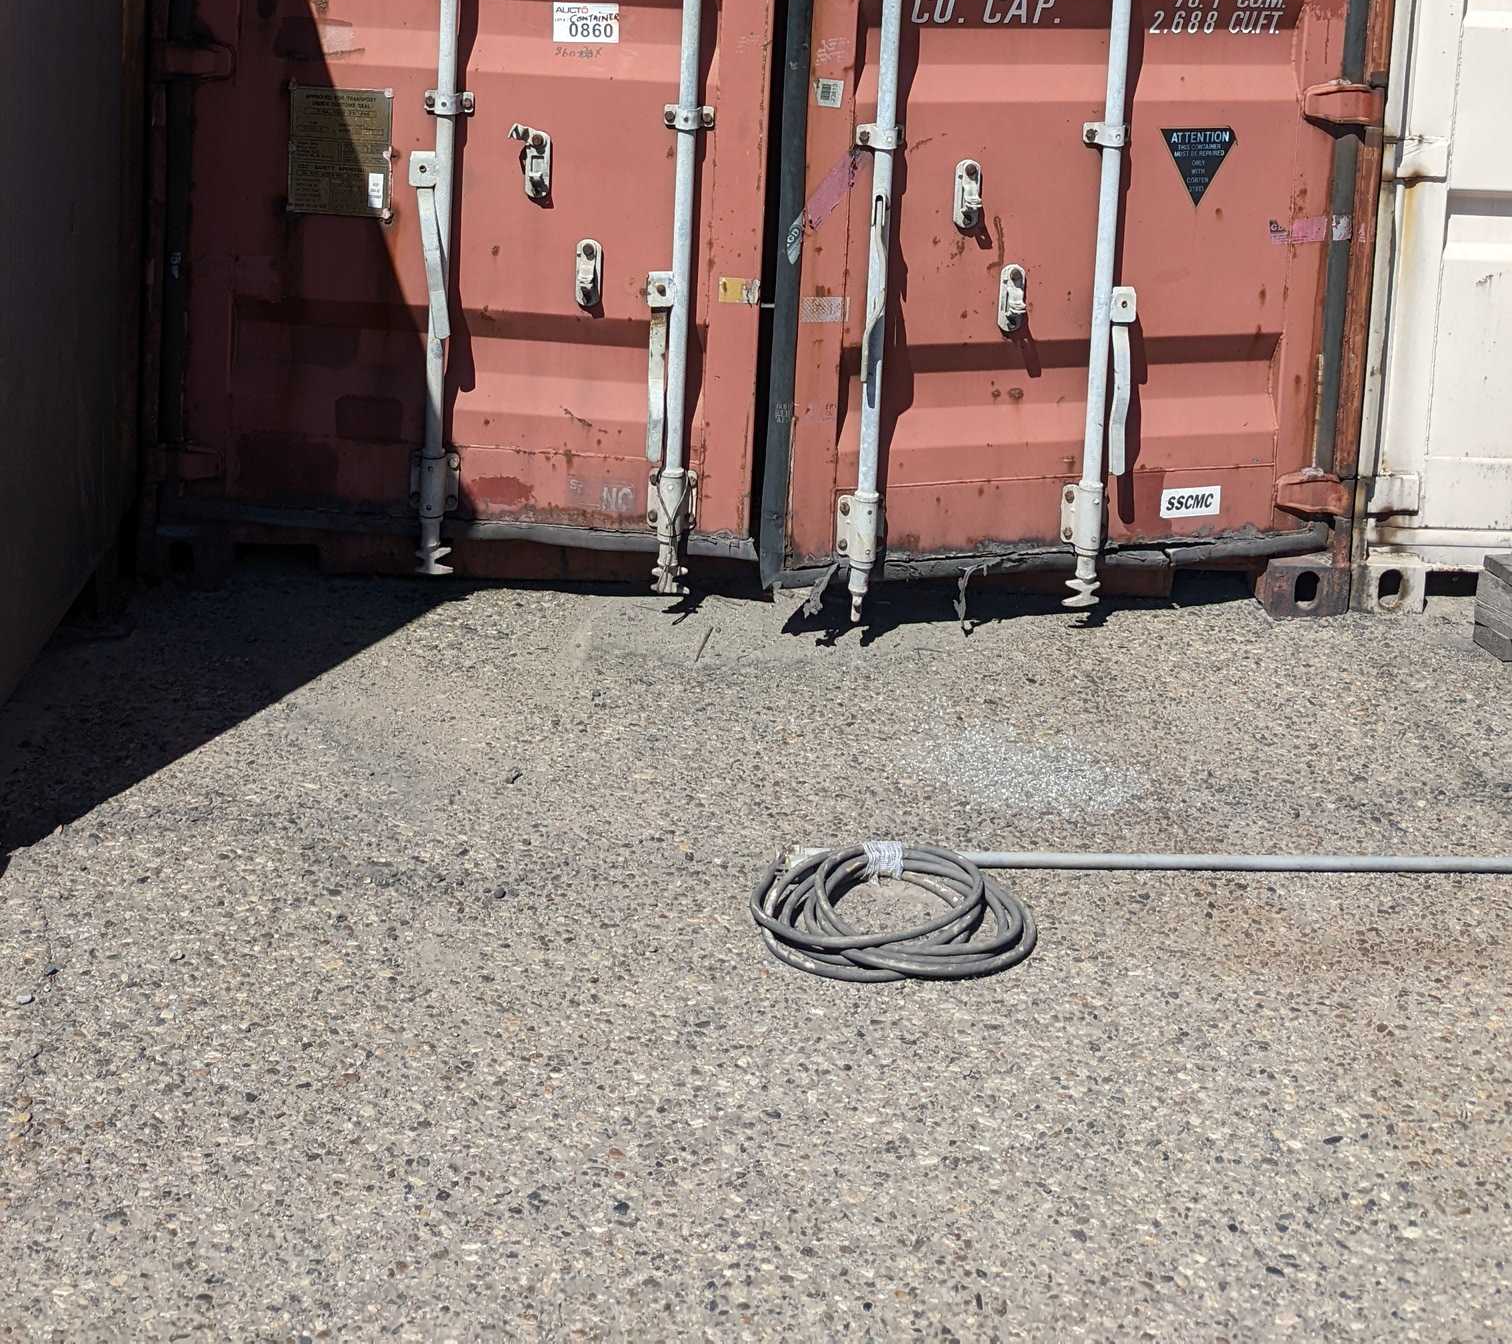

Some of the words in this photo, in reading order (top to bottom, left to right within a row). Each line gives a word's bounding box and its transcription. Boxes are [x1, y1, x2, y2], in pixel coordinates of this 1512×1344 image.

[569, 23, 613, 38] 0860
[1171, 131, 1230, 143] ATTENTION
[1166, 493, 1214, 511] SSCMC
